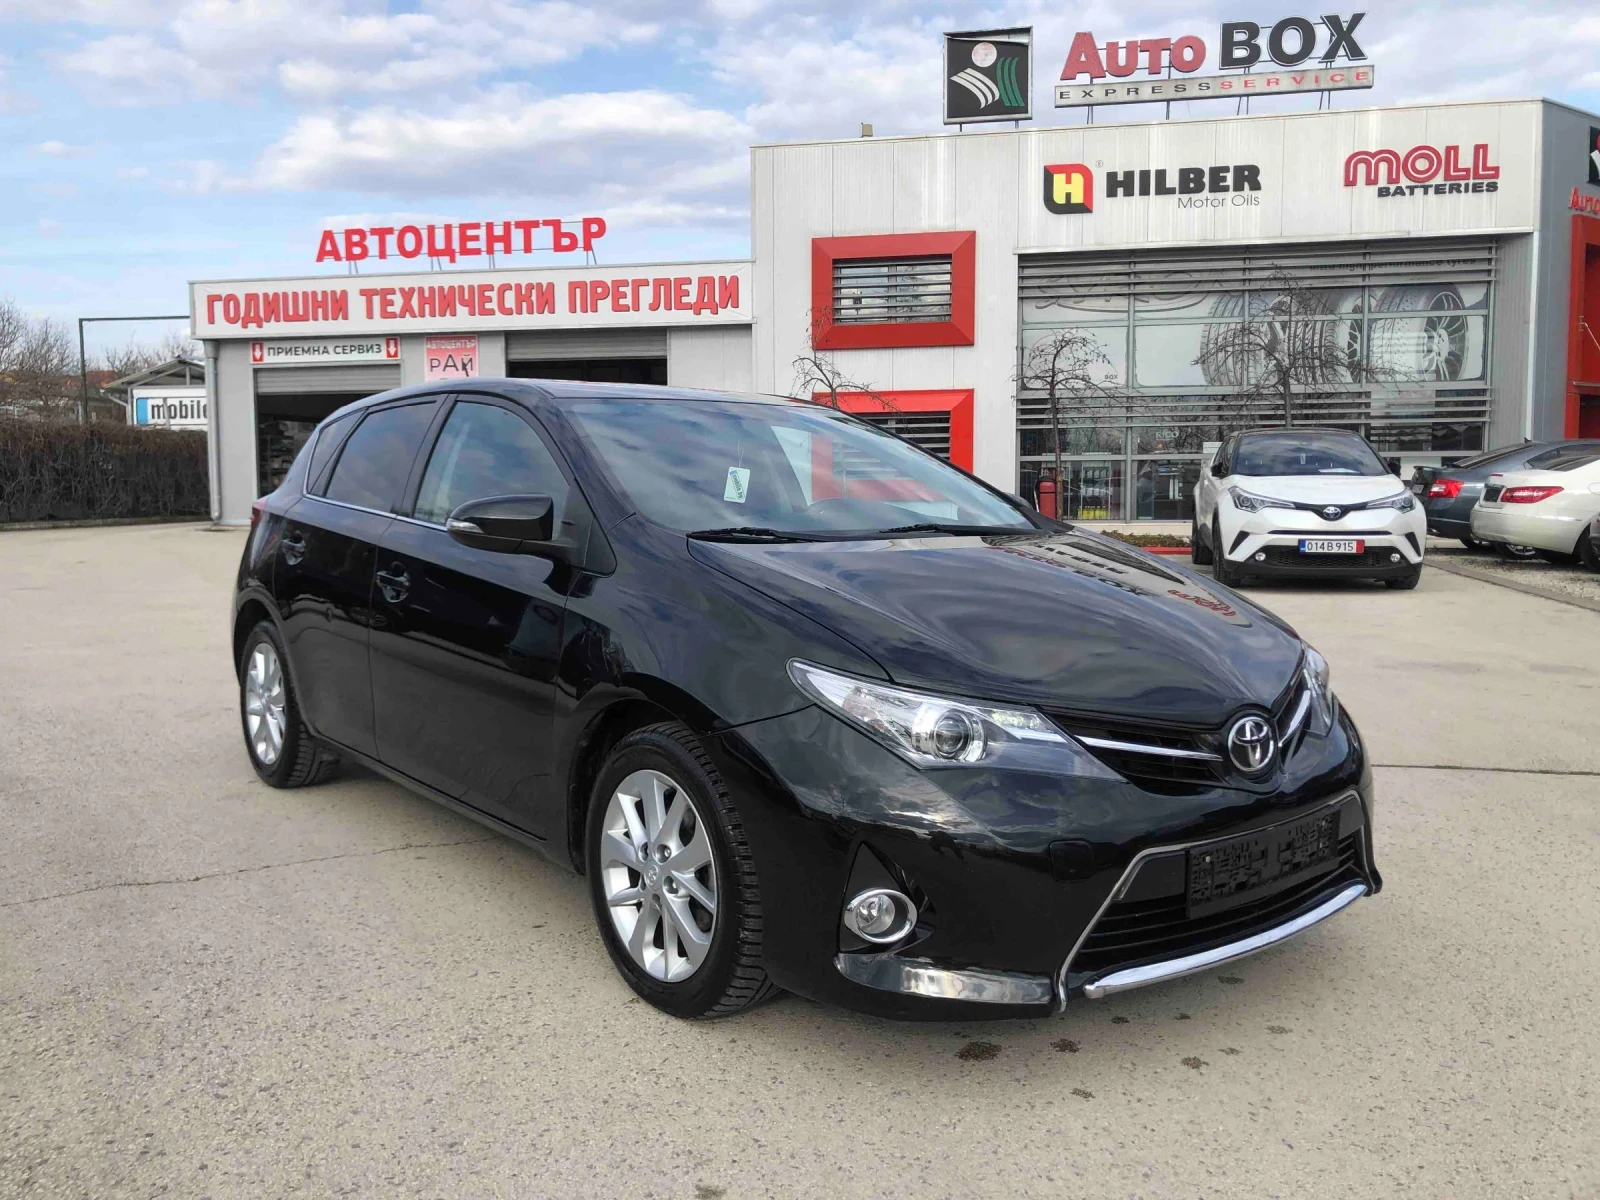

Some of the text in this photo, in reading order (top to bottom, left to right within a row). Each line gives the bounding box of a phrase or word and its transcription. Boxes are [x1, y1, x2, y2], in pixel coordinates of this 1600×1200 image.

[1060, 12, 1368, 80] AUTO BOX
[1106, 164, 1262, 198] HILBER
[1377, 181, 1499, 198] BATTERIES
[1177, 194, 1260, 209] Motor Oils
[316, 217, 607, 264] АВТОЦЕНТЪР
[206, 275, 740, 329] ГОДИШНИ ТЕХНИЧЕСКИ ПРЕГЛЕДИ
[267, 343, 382, 357] ПРИЕМНА СЕРВИЗ
[427, 339, 476, 349] АВТОЦЕНТЪР
[430, 353, 474, 373] РАЙ
